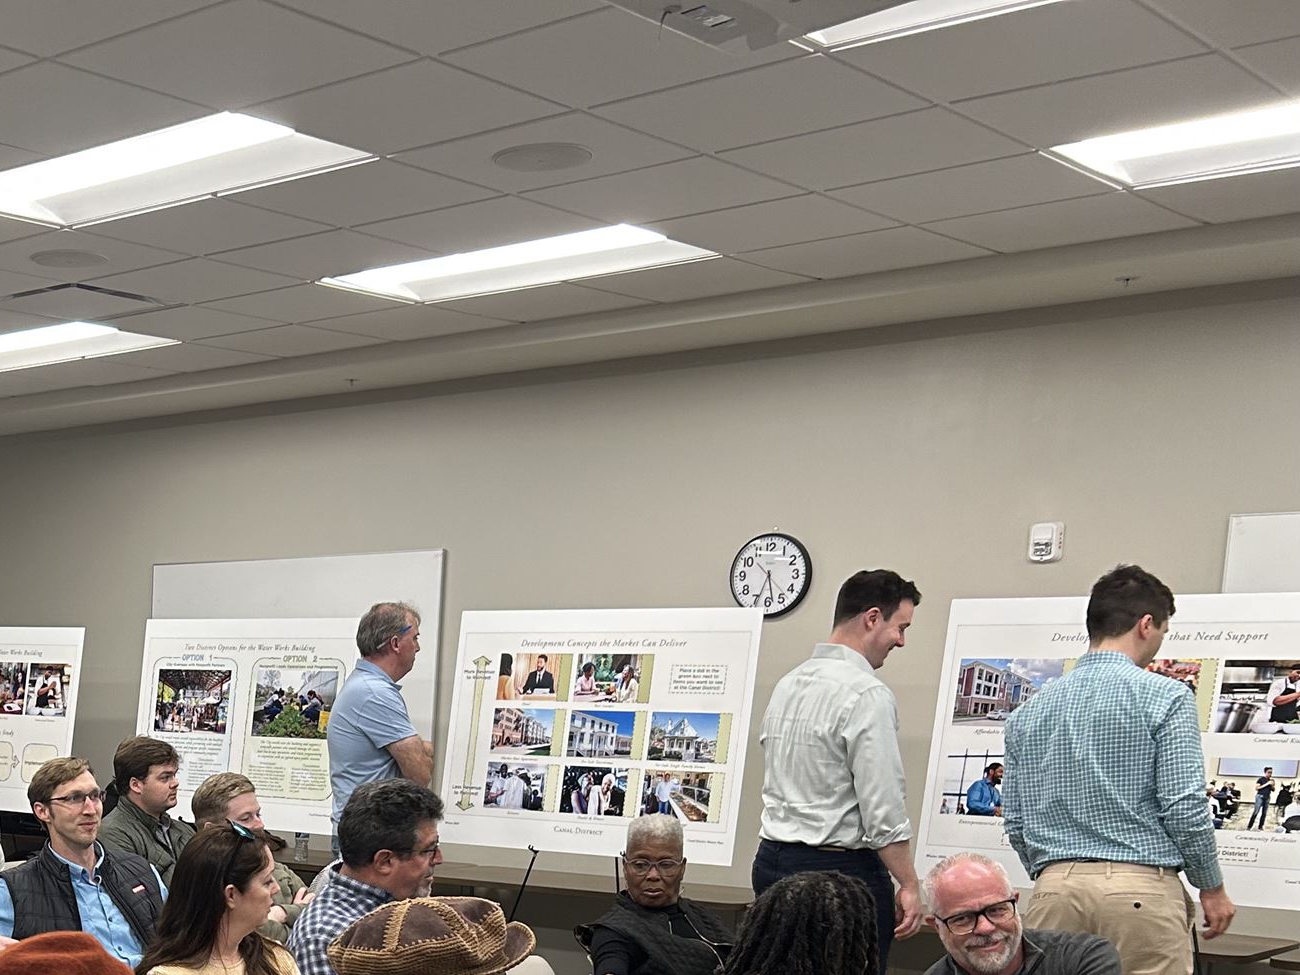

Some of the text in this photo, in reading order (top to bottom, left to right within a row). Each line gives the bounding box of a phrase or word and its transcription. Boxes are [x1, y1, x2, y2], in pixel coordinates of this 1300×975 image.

[755, 546, 762, 558] 11
[766, 542, 777, 552] 12
[782, 545, 786, 556] 1
[743, 556, 754, 568] 10
[789, 554, 797, 566] 2
[739, 570, 746, 581] 9
[791, 568, 800, 580] 3
[742, 584, 750, 595] 8
[787, 583, 795, 594] 4
[752, 594, 760, 605] 7
[764, 596, 772, 607] 6
[777, 593, 785, 604] 5
[1051, 632, 1269, 643] Develop that Need Support
[218, 643, 237, 652] Options
[238, 644, 248, 652] for
[291, 645, 316, 653] Building
[521, 639, 688, 649] Development Concepts the Market Can Deliver
[1235, 834, 1268, 843] Community
